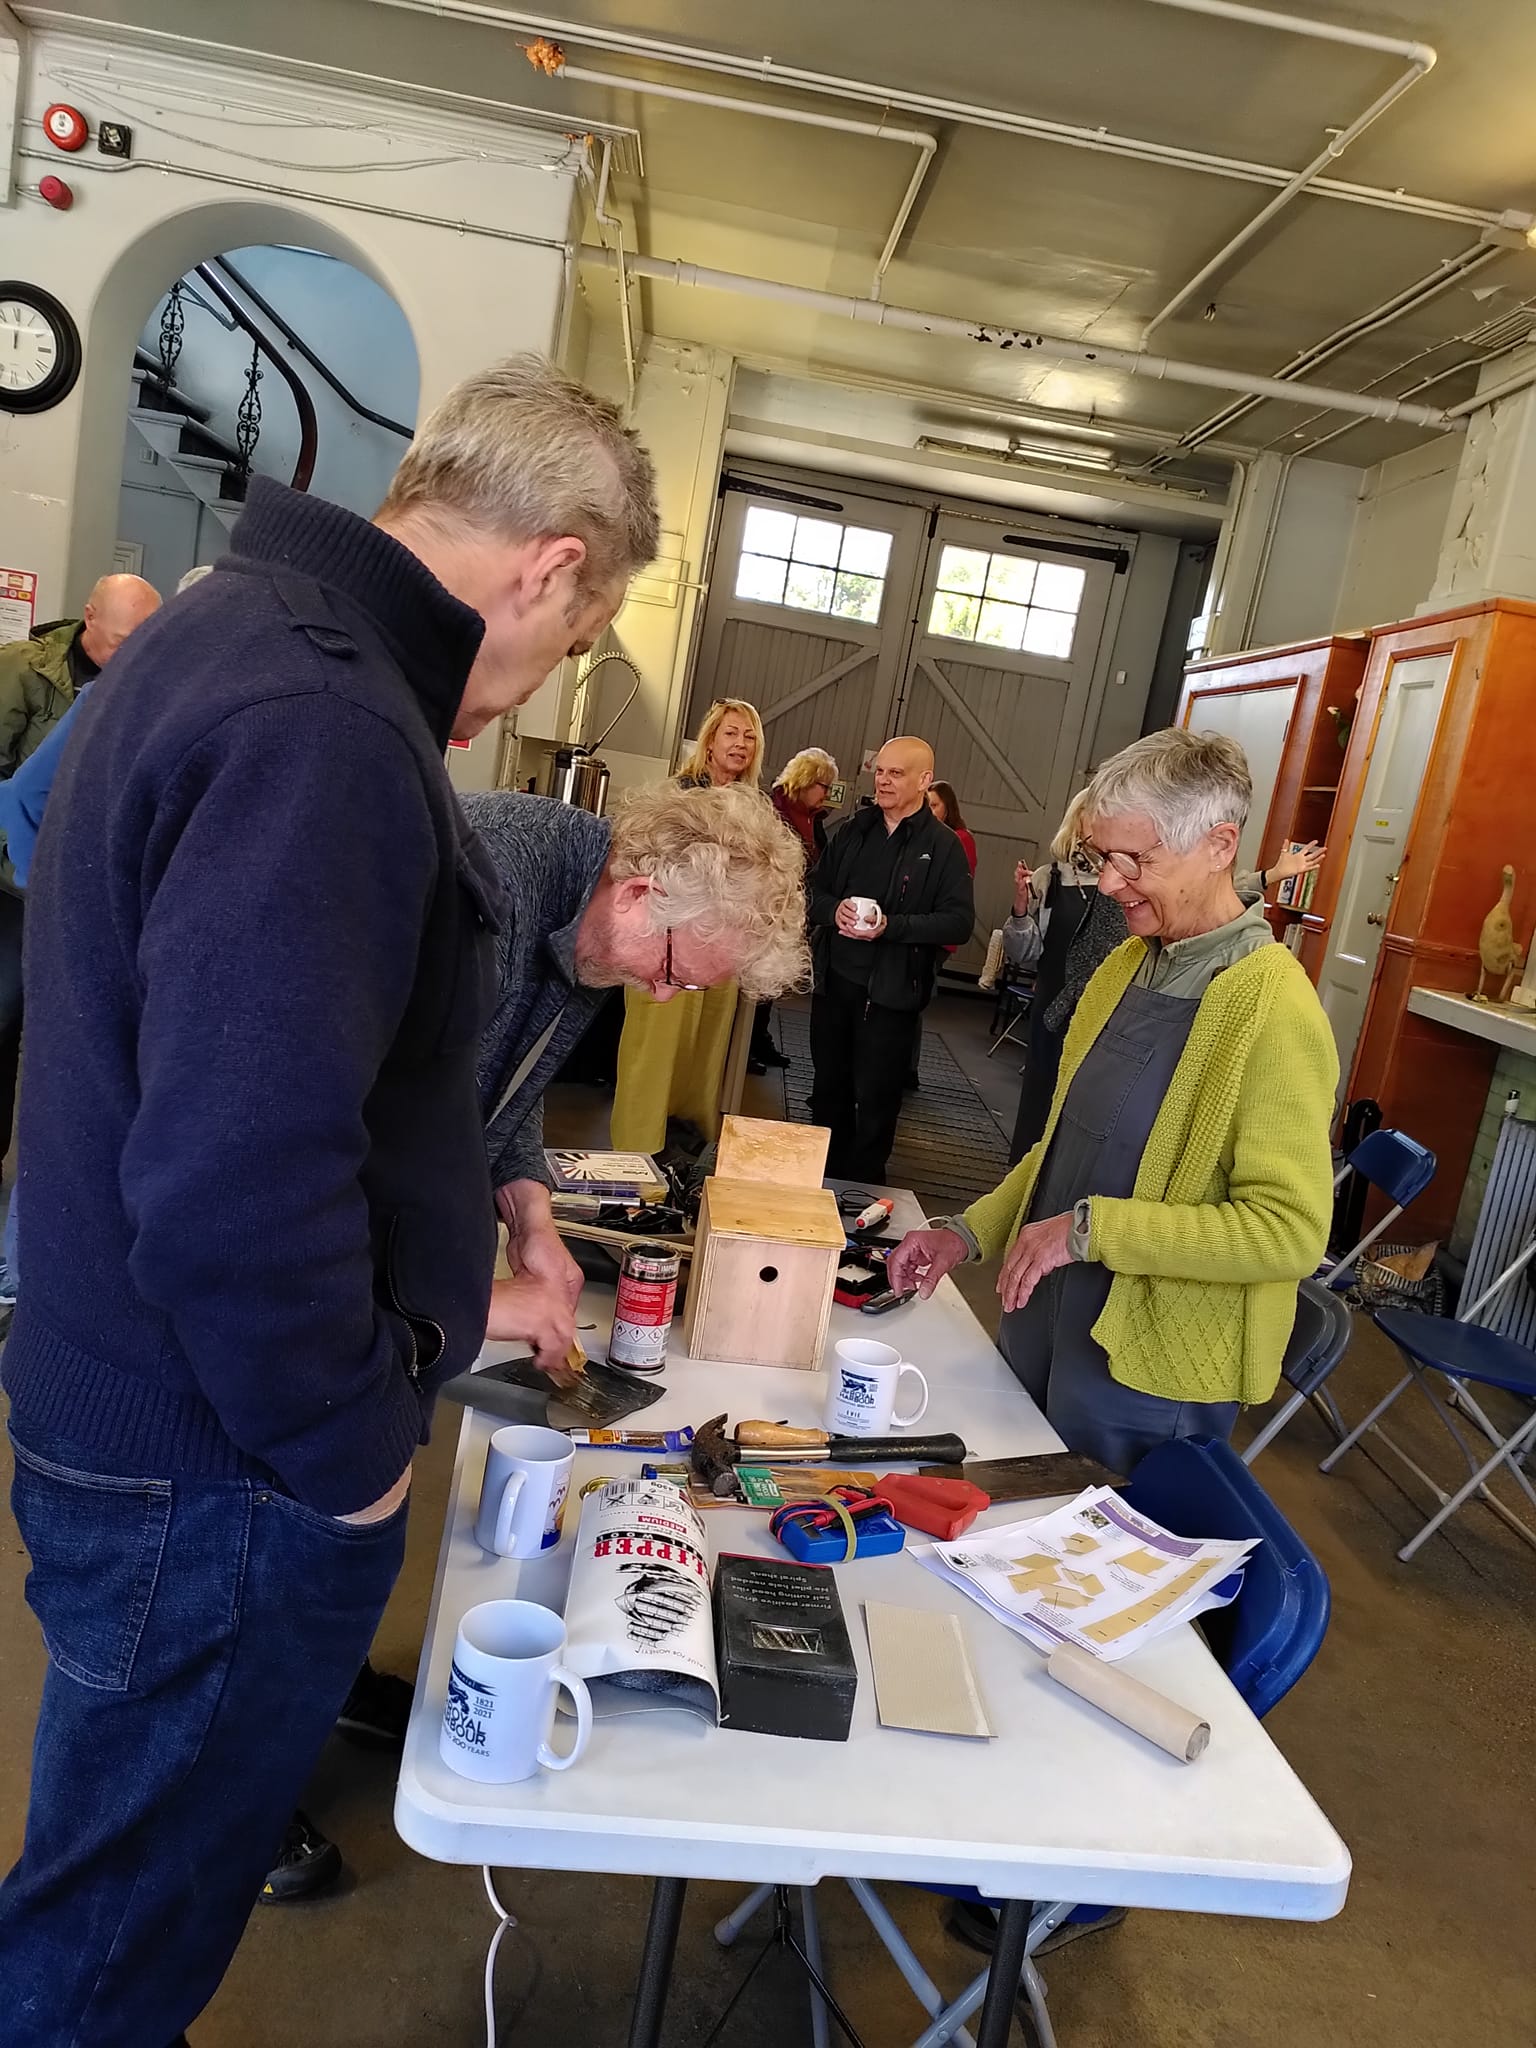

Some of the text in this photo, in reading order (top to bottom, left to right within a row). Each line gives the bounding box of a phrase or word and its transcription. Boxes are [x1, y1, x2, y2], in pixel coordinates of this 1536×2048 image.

[641, 1516, 685, 1531] MEDIUM
[599, 1531, 654, 1541] WOOL
[593, 1537, 706, 1578] LIPPER
[730, 1576, 766, 1585] needed
[750, 1571, 807, 1583] Spiral shank
[733, 1593, 758, 1602] drive
[751, 1588, 777, 1597] head
[778, 1591, 810, 1599] cutting
[760, 1598, 799, 1607] positive
[475, 1696, 494, 1708] 1821
[446, 1699, 487, 1735] ROYAL
[473, 1707, 492, 1719] 2021
[452, 1735, 491, 1757] 200 YEARS
